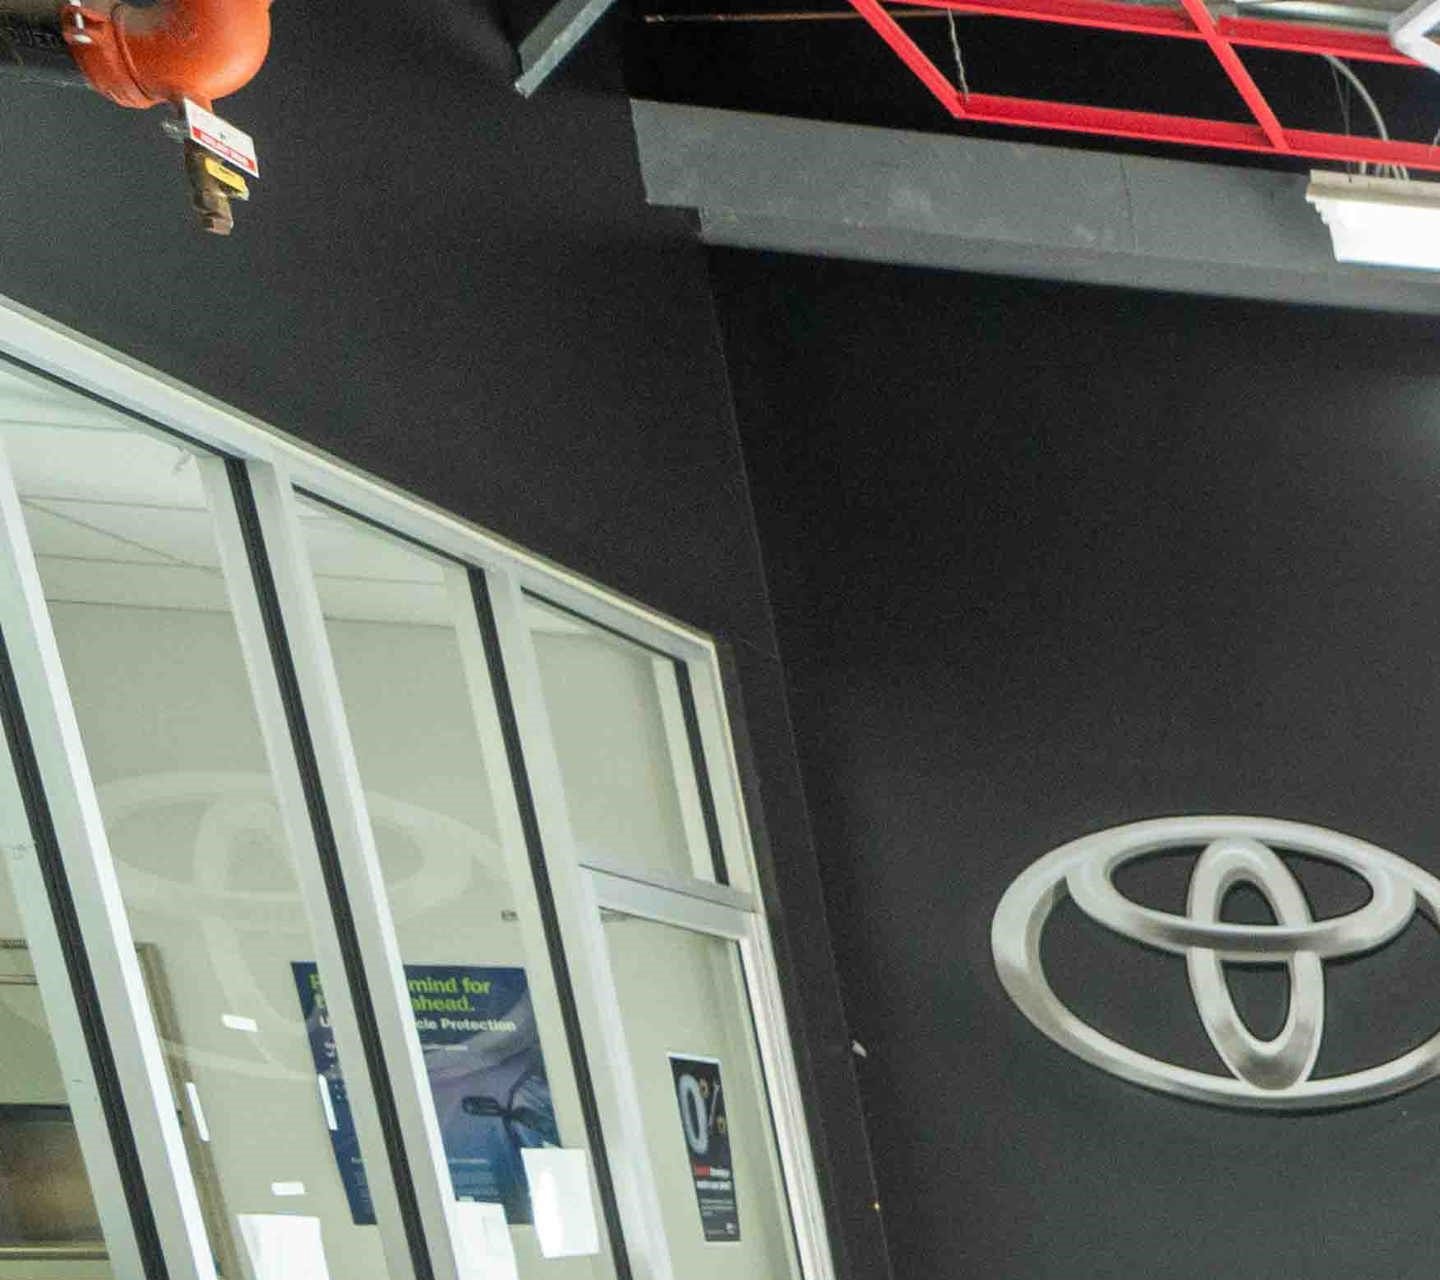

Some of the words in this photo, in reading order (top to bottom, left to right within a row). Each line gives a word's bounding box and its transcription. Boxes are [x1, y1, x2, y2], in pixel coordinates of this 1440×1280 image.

[408, 977, 457, 994] mind
[462, 977, 491, 994] for
[441, 1018, 516, 1032] Protection
